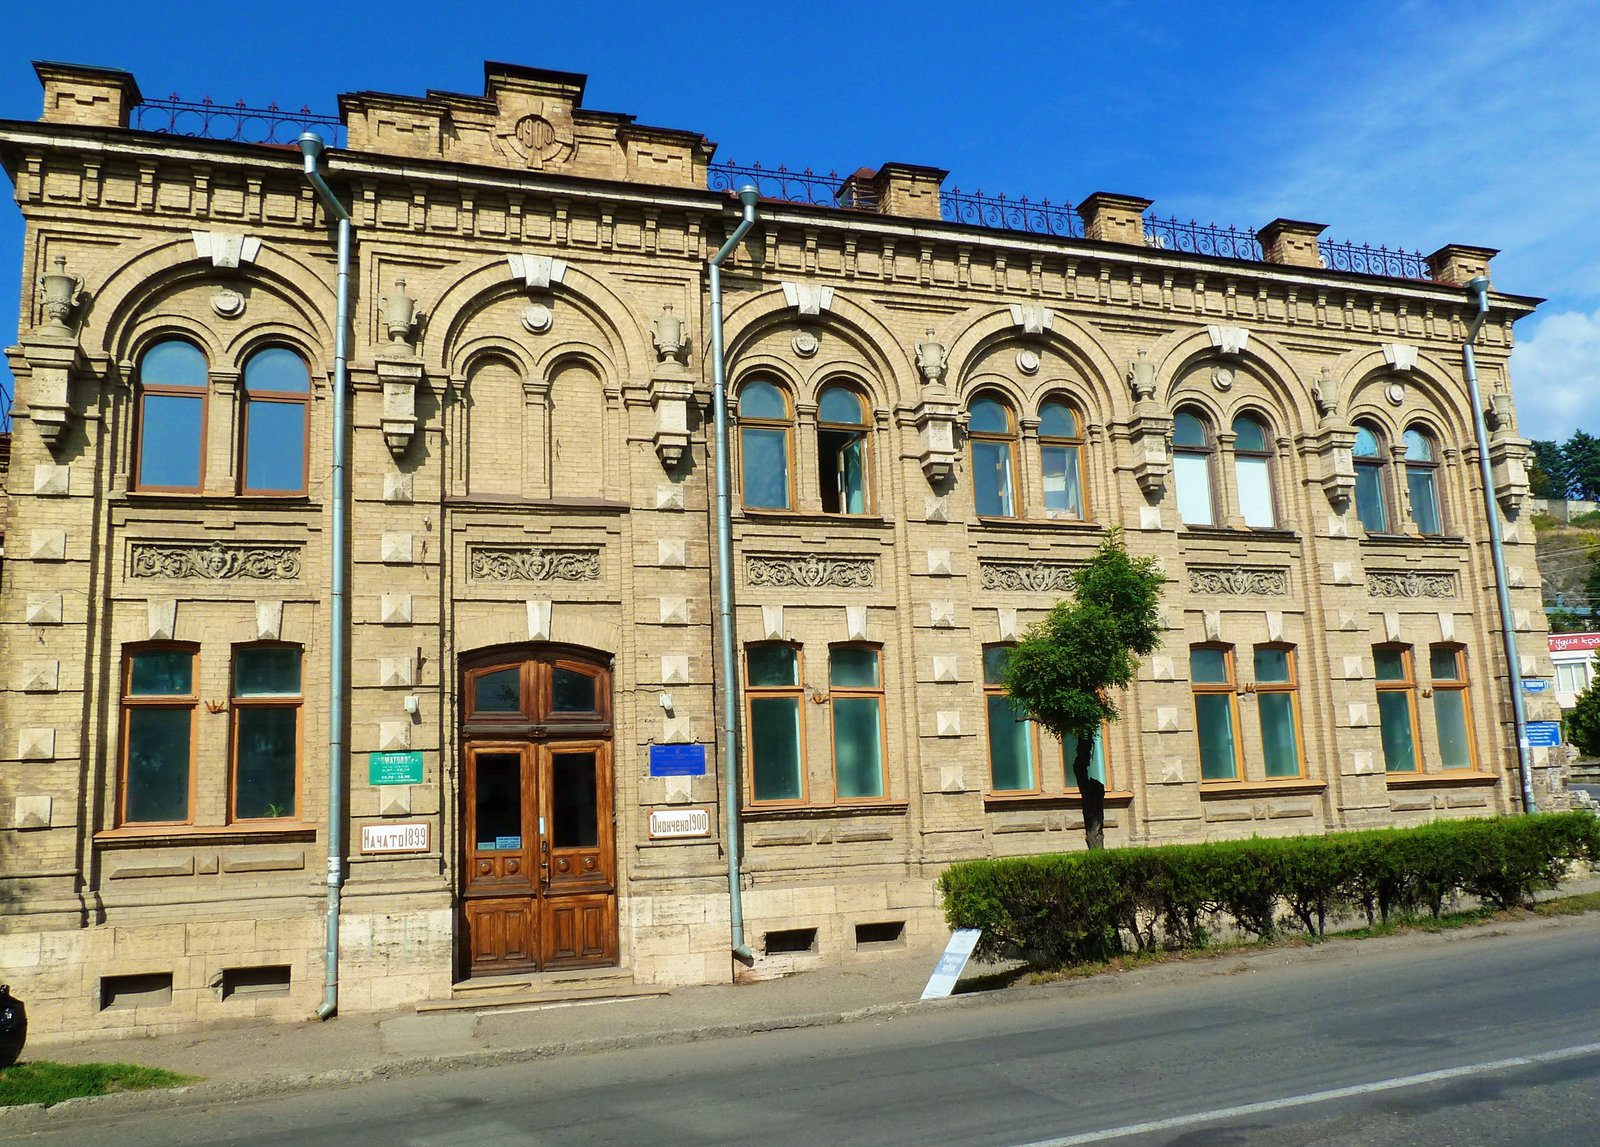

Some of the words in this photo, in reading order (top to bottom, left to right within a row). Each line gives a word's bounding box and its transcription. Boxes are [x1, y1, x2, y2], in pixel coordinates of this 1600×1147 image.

[518, 119, 552, 149] 1900
[689, 813, 707, 831] 1900
[363, 828, 404, 849] Начато
[404, 827, 426, 847] 1899
